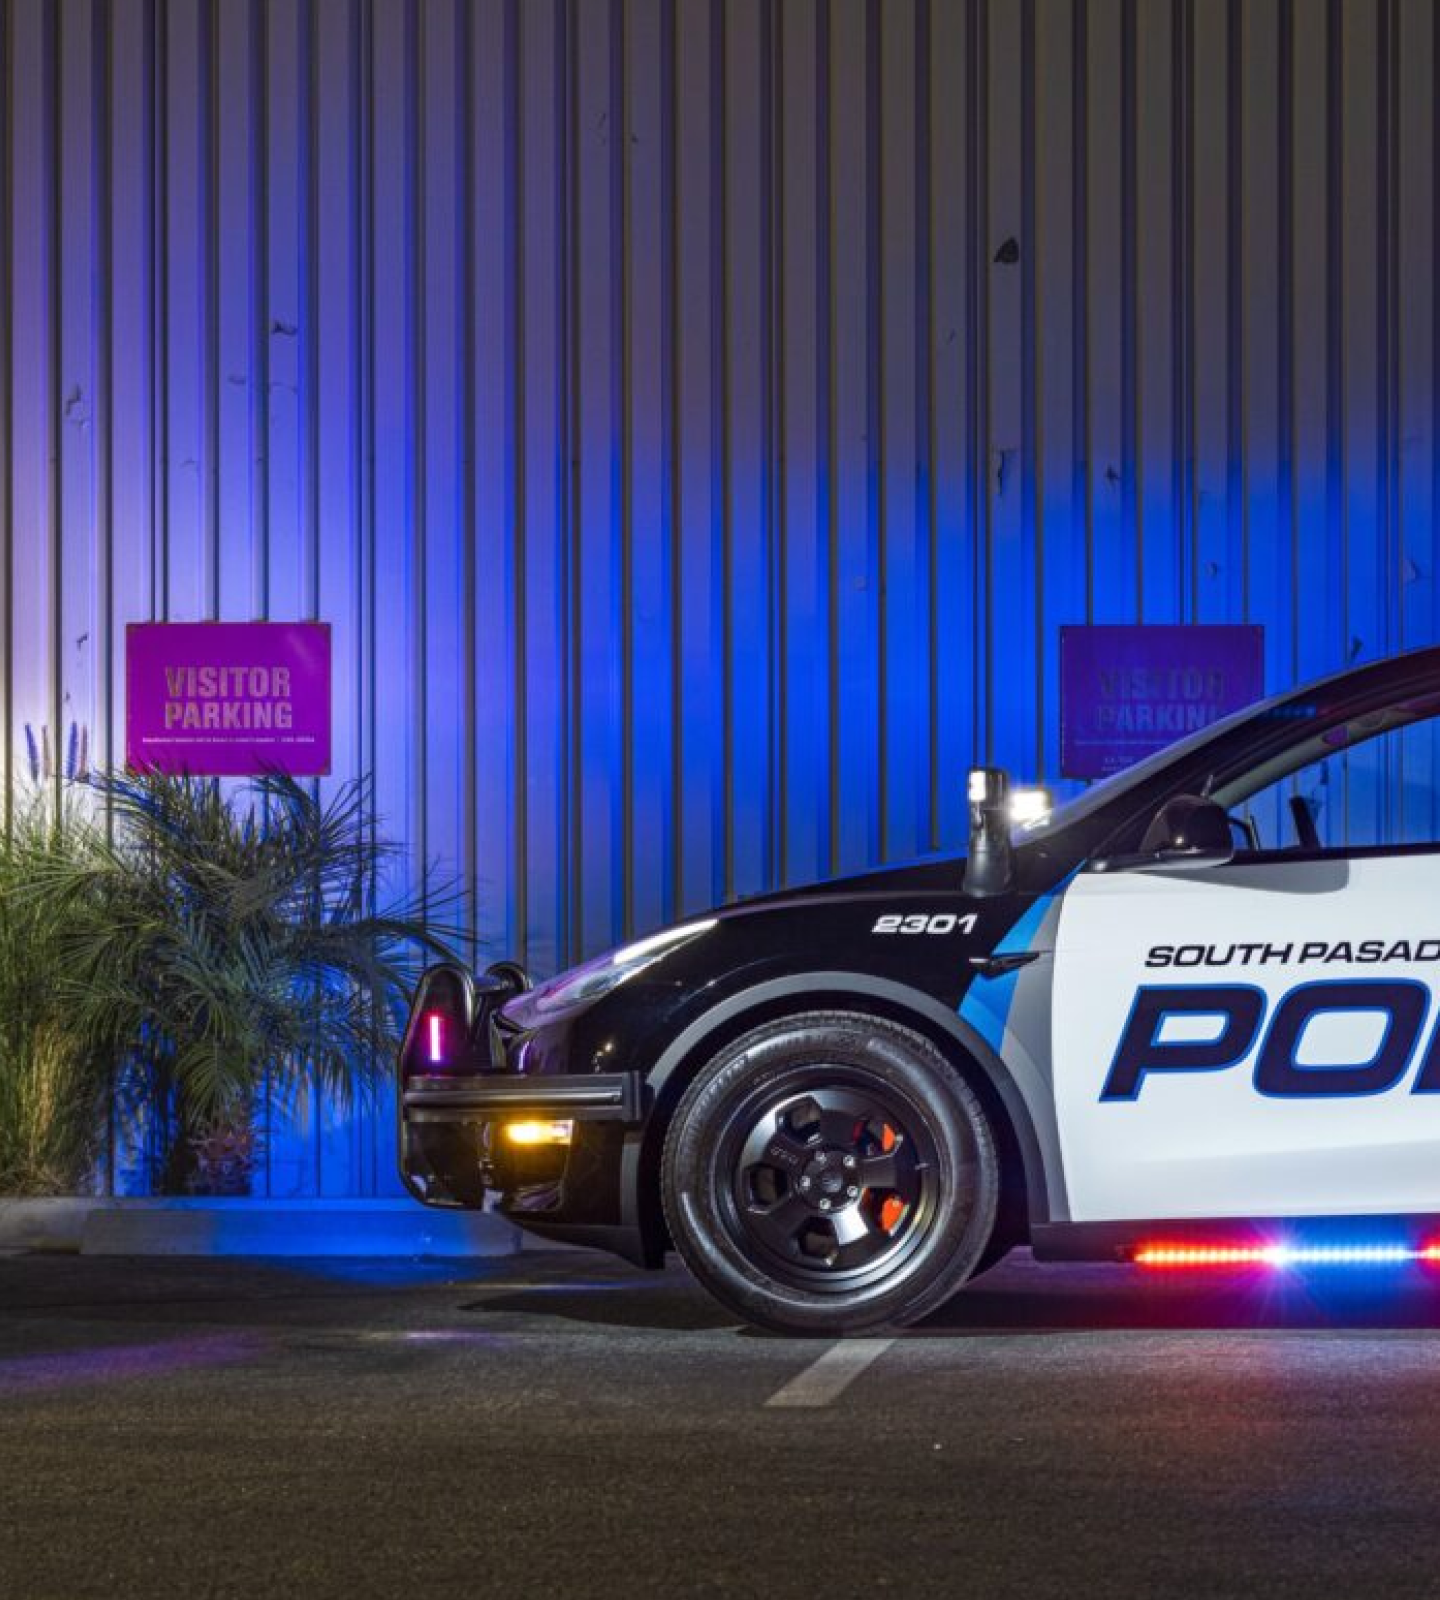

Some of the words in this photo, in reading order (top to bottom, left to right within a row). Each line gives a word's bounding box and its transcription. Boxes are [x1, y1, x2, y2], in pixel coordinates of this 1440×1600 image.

[165, 667, 291, 697] VISITOR
[1099, 667, 1225, 700] VISITOR
[164, 702, 293, 730] PARKING
[871, 913, 978, 934] 2301
[1145, 942, 1293, 968] SOUTH
